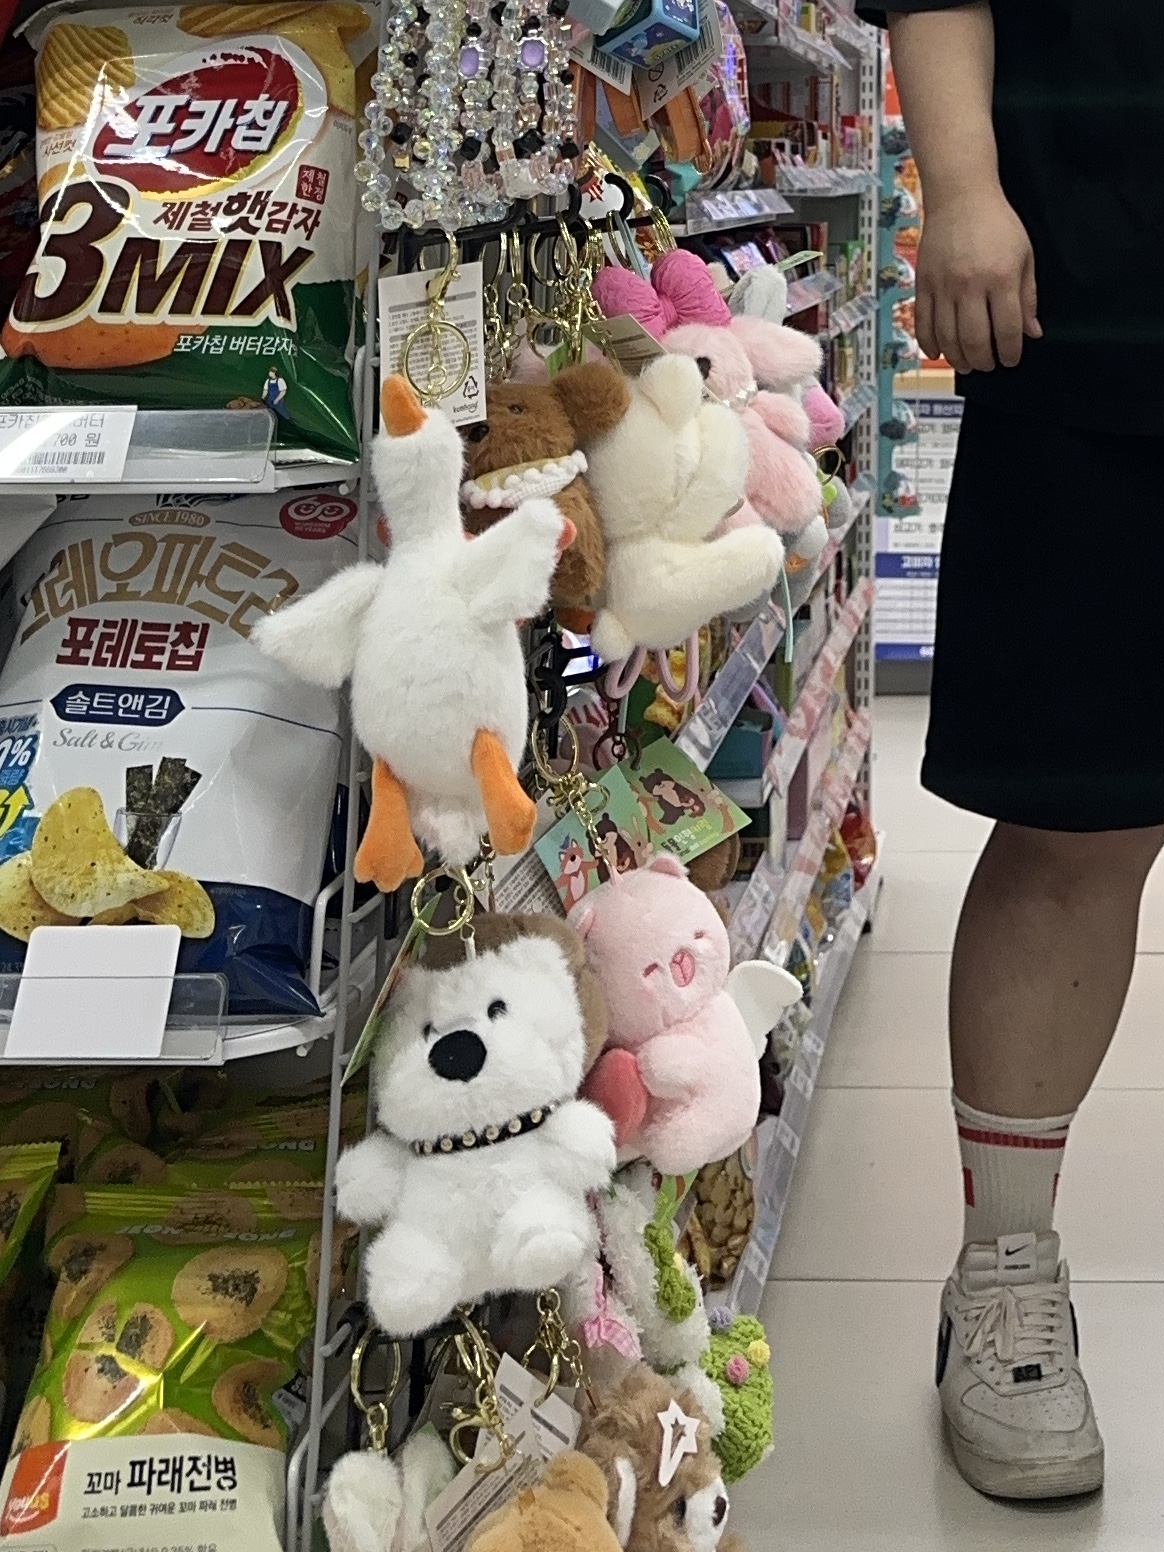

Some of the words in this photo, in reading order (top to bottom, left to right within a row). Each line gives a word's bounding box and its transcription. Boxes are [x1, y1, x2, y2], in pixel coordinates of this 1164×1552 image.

[103, 94, 288, 158] 포카칩
[84, 432, 101, 448] 원
[132, 508, 173, 525] SINCE
[175, 509, 205, 526] 1980
[56, 616, 211, 672] 포레토칩
[64, 690, 171, 720] 솔트앤김
[53, 728, 99, 748] Salt
[100, 732, 115, 749] &
[84, 1470, 121, 1495] 꼬마
[126, 1454, 238, 1496] 파래전병
